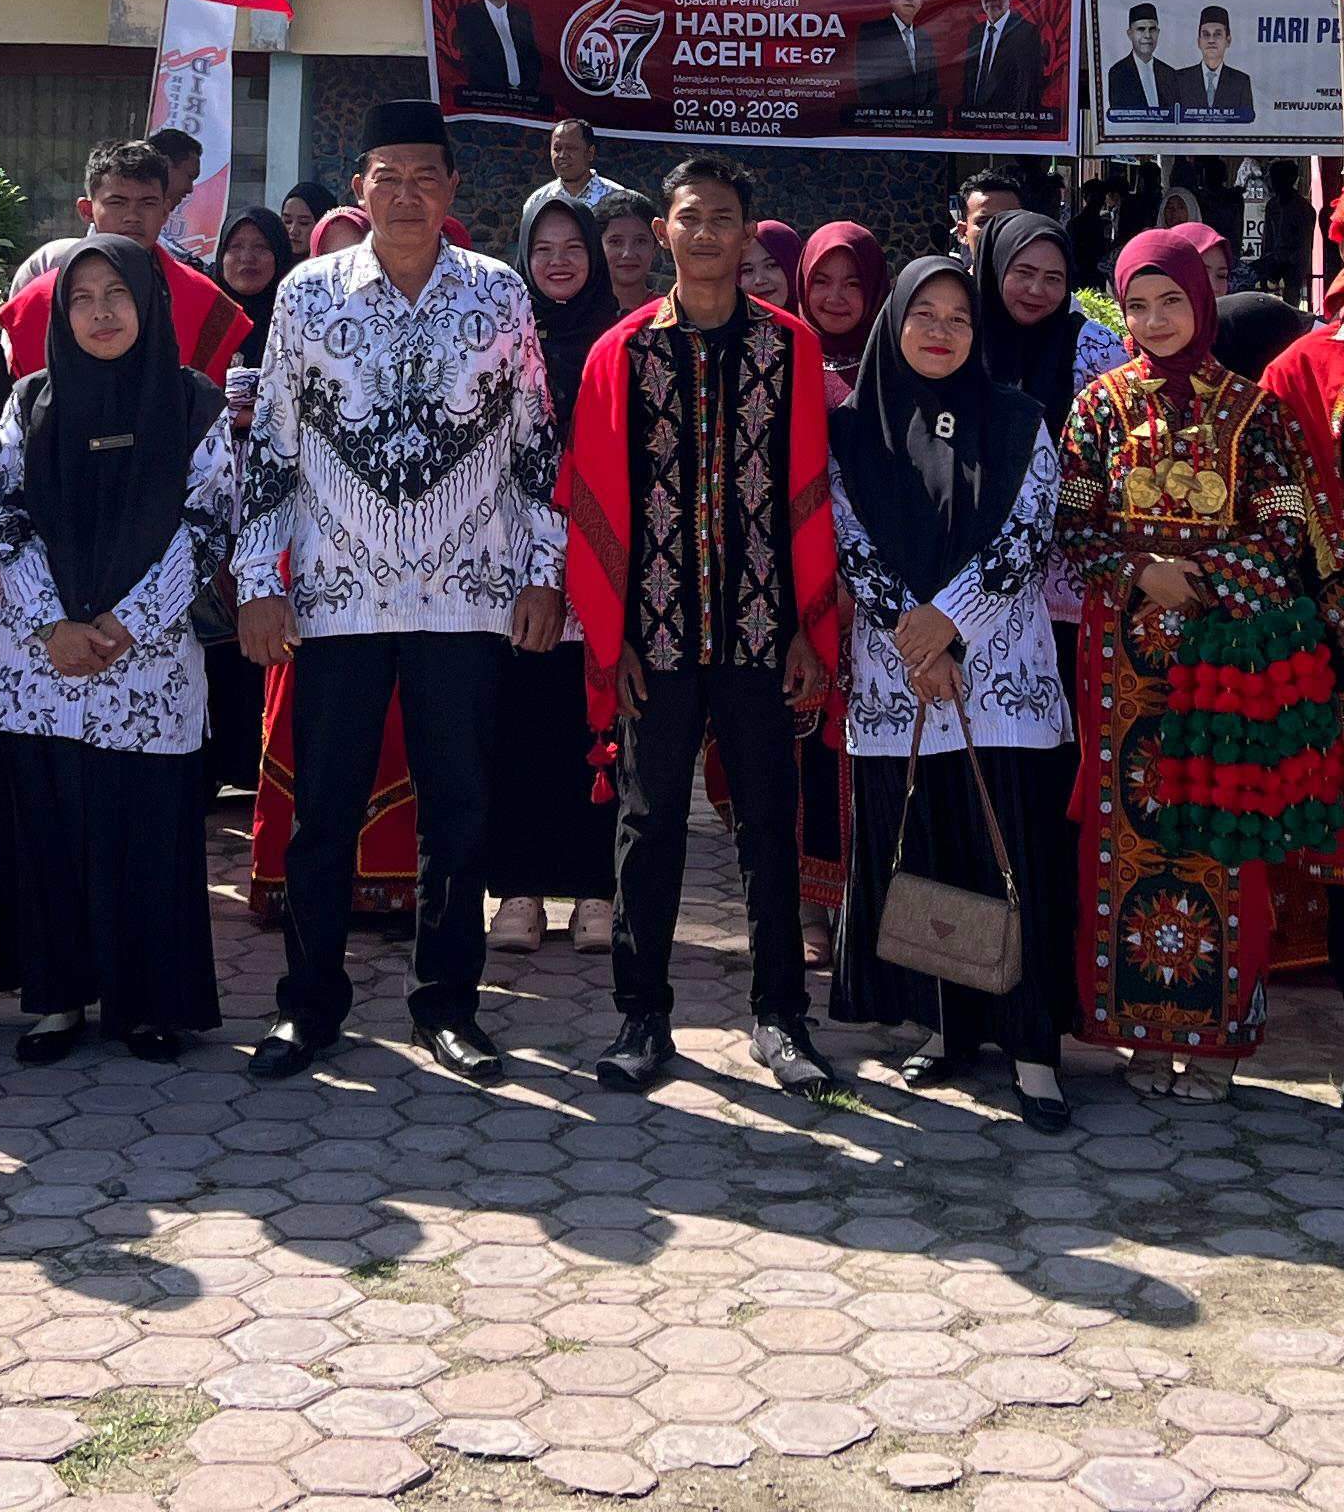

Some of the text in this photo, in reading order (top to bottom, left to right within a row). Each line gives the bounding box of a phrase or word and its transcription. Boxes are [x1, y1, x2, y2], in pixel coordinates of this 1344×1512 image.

[676, 12, 846, 38] HARDIKDA
[1258, 17, 1309, 43] HARI
[672, 41, 836, 67] ACEH KE-67
[674, 119, 781, 135] SMAN 1 BADAR
